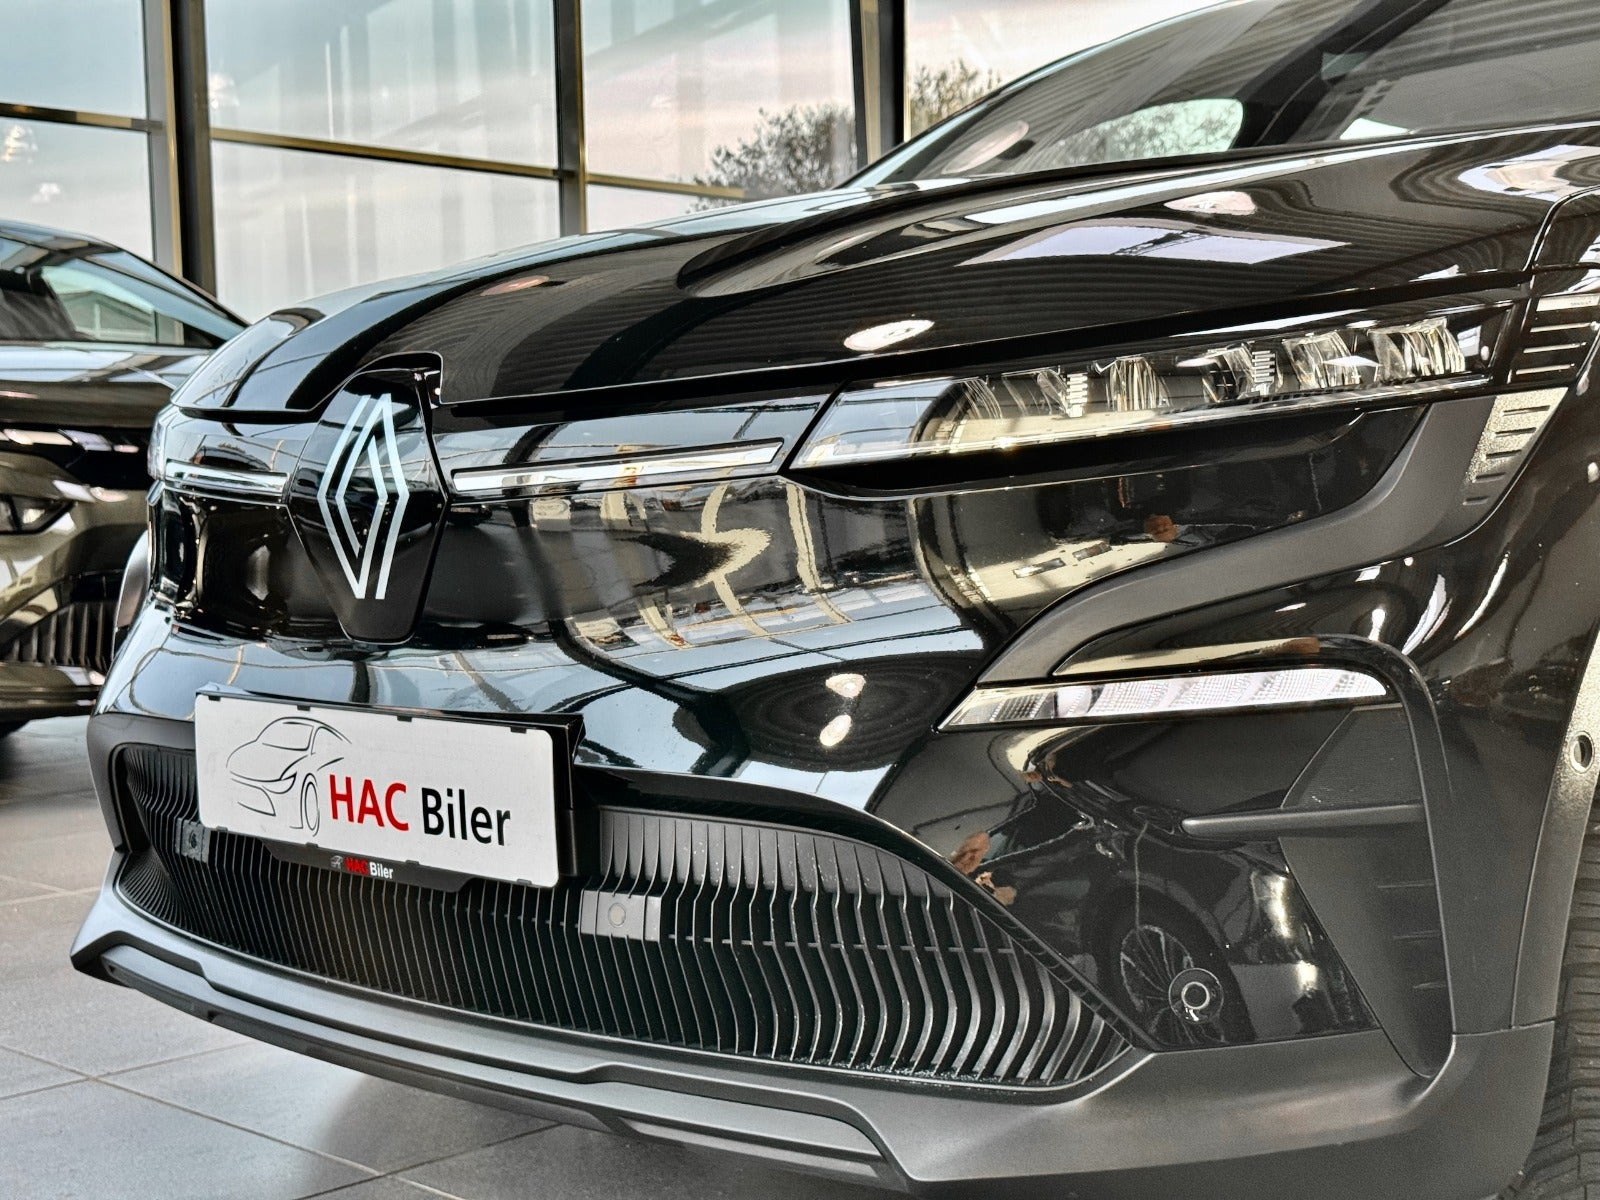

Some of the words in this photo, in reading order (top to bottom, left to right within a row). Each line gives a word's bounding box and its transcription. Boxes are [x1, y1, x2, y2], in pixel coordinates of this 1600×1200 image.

[328, 773, 410, 832] HAC
[420, 786, 511, 846] Biler
[345, 856, 369, 876] HAC
[369, 861, 394, 880] Biler
